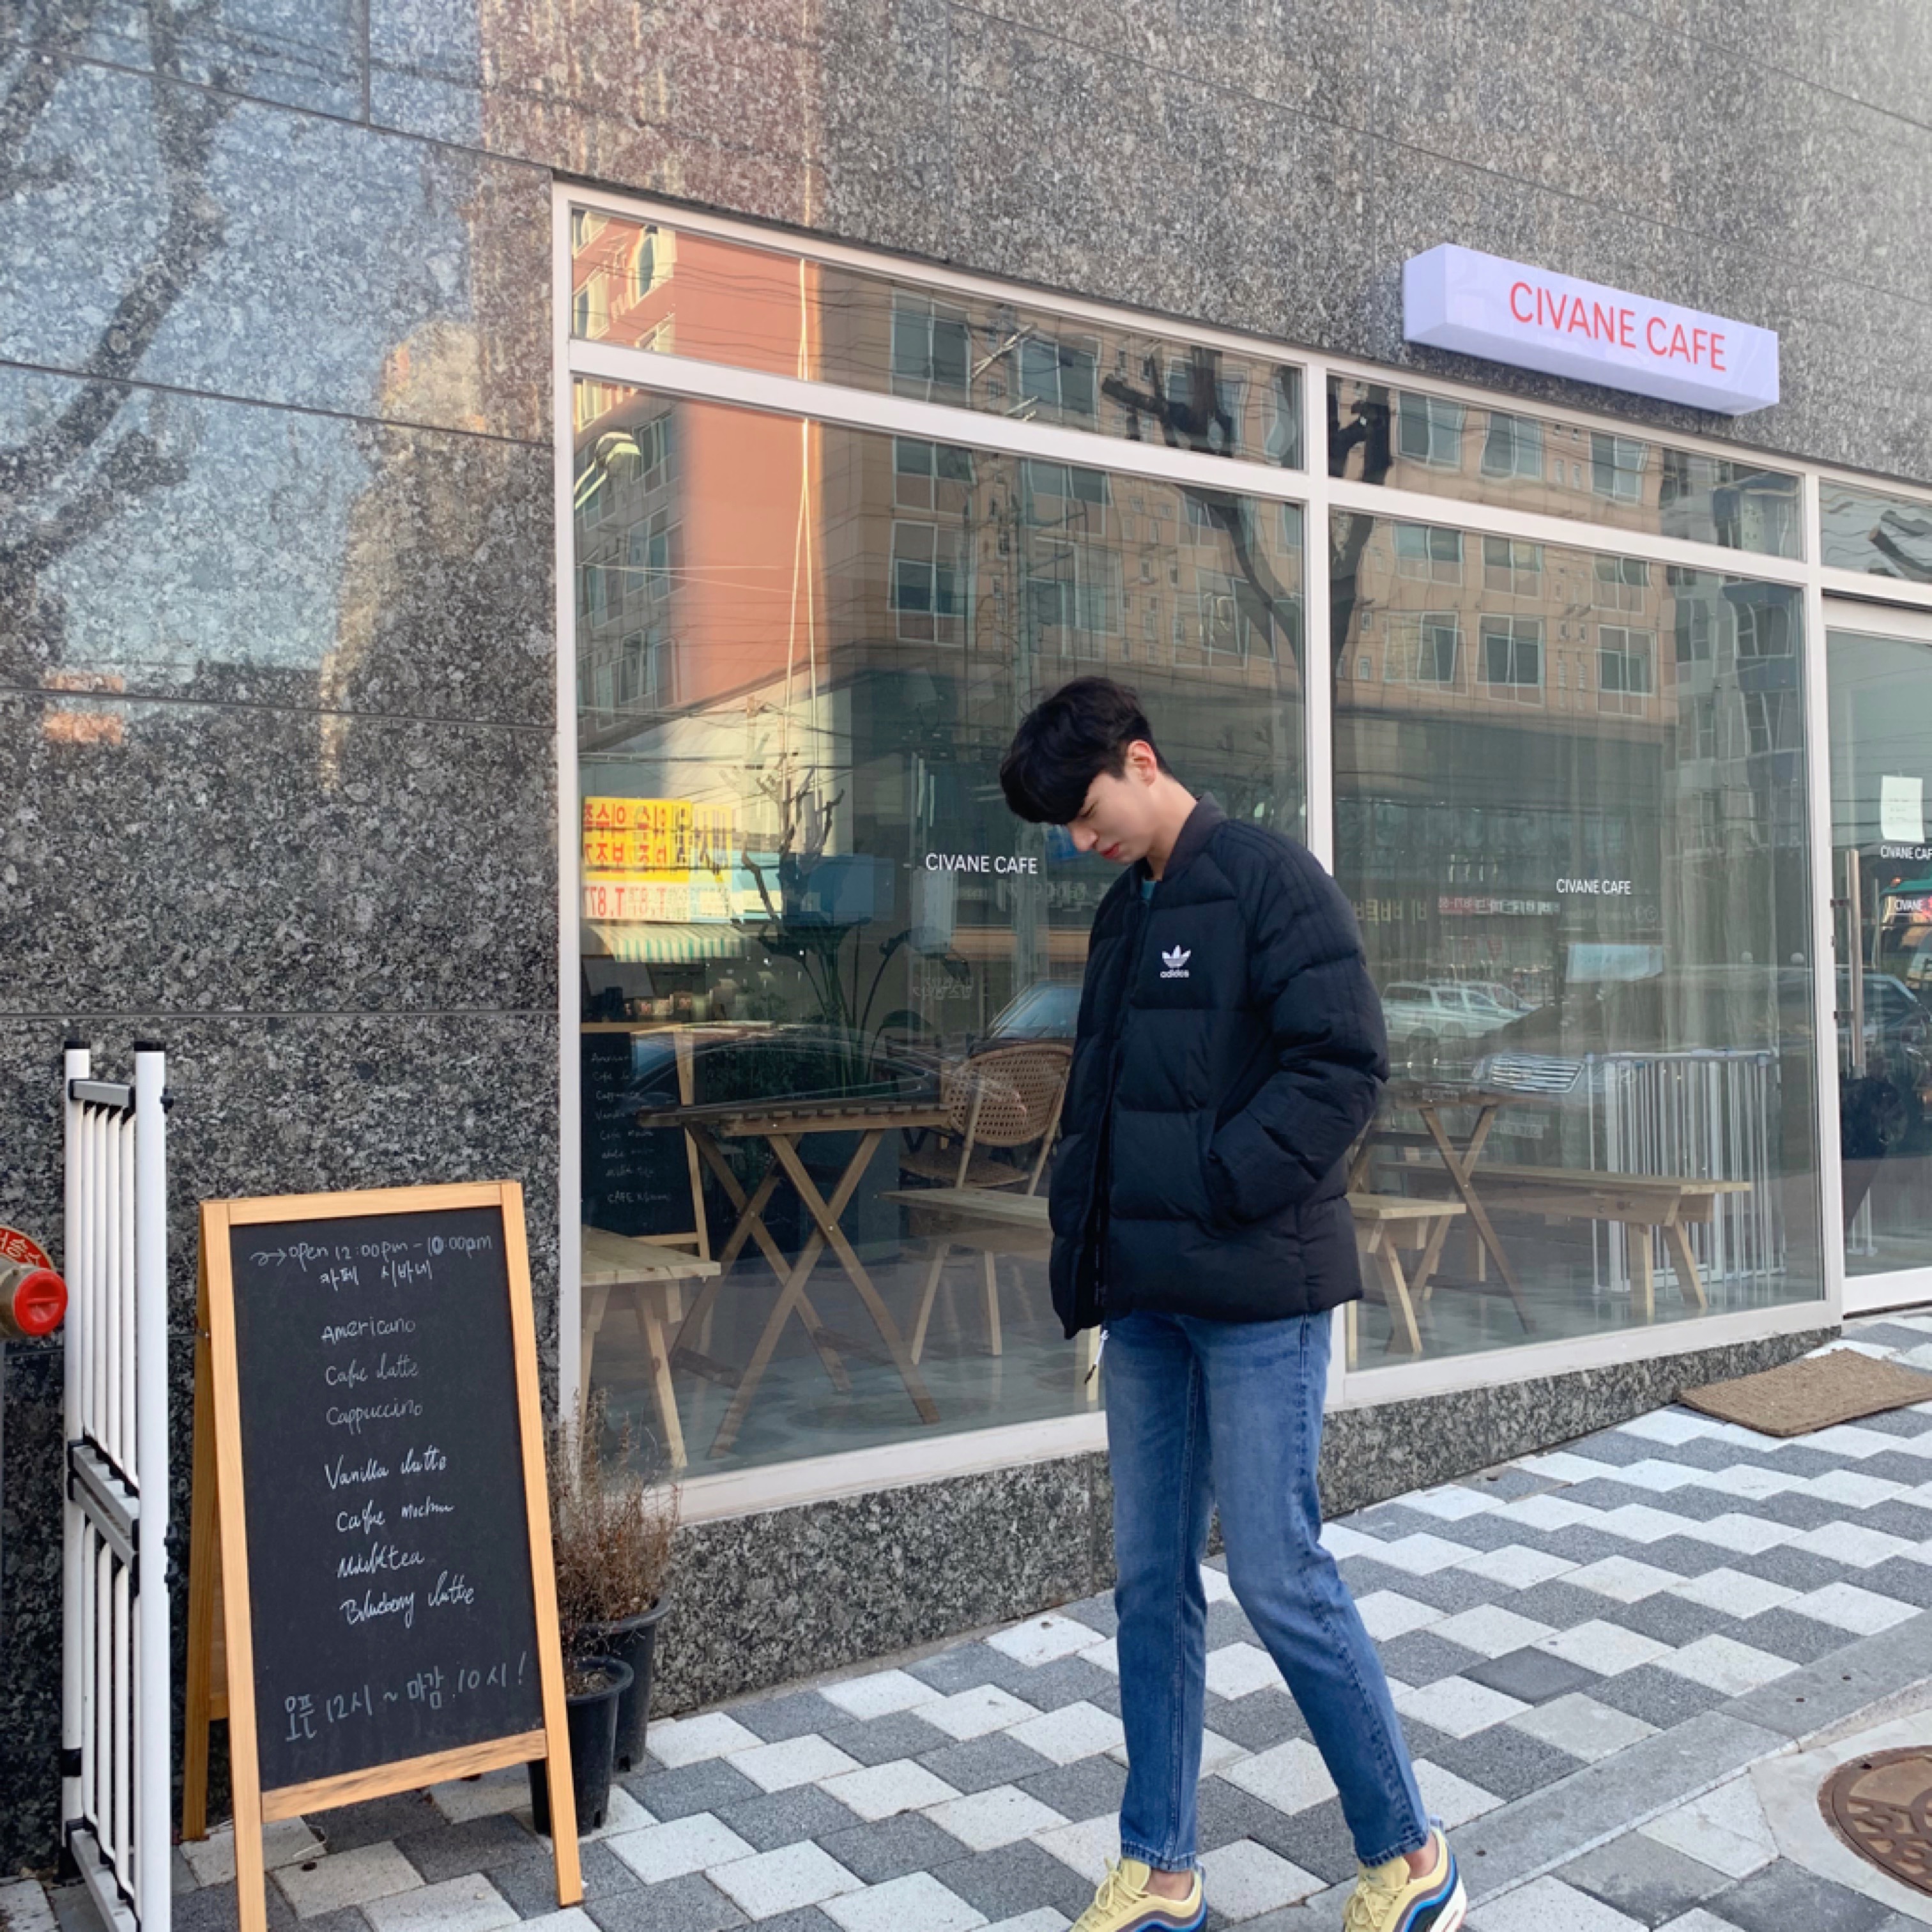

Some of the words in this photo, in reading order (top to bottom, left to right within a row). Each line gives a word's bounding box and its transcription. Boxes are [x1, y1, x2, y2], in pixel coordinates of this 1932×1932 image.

[1509, 281, 1636, 349] CIVANE
[1646, 316, 1726, 372] CAFE
[925, 853, 990, 873] CIVANE
[993, 856, 1038, 874] CAFE
[1880, 845, 1914, 860] CIVANE
[1915, 847, 1932, 861] CAF
[1556, 878, 1600, 894] CIVANE
[1602, 880, 1632, 895] CAFE
[1160, 969, 1189, 978] adidas
[321, 1316, 416, 1344] Americano
[326, 1397, 424, 1435] Cappuccino
[324, 1454, 389, 1489] Vanilla
[284, 1694, 318, 1742] 오픈
[325, 1684, 373, 1723] 12시
